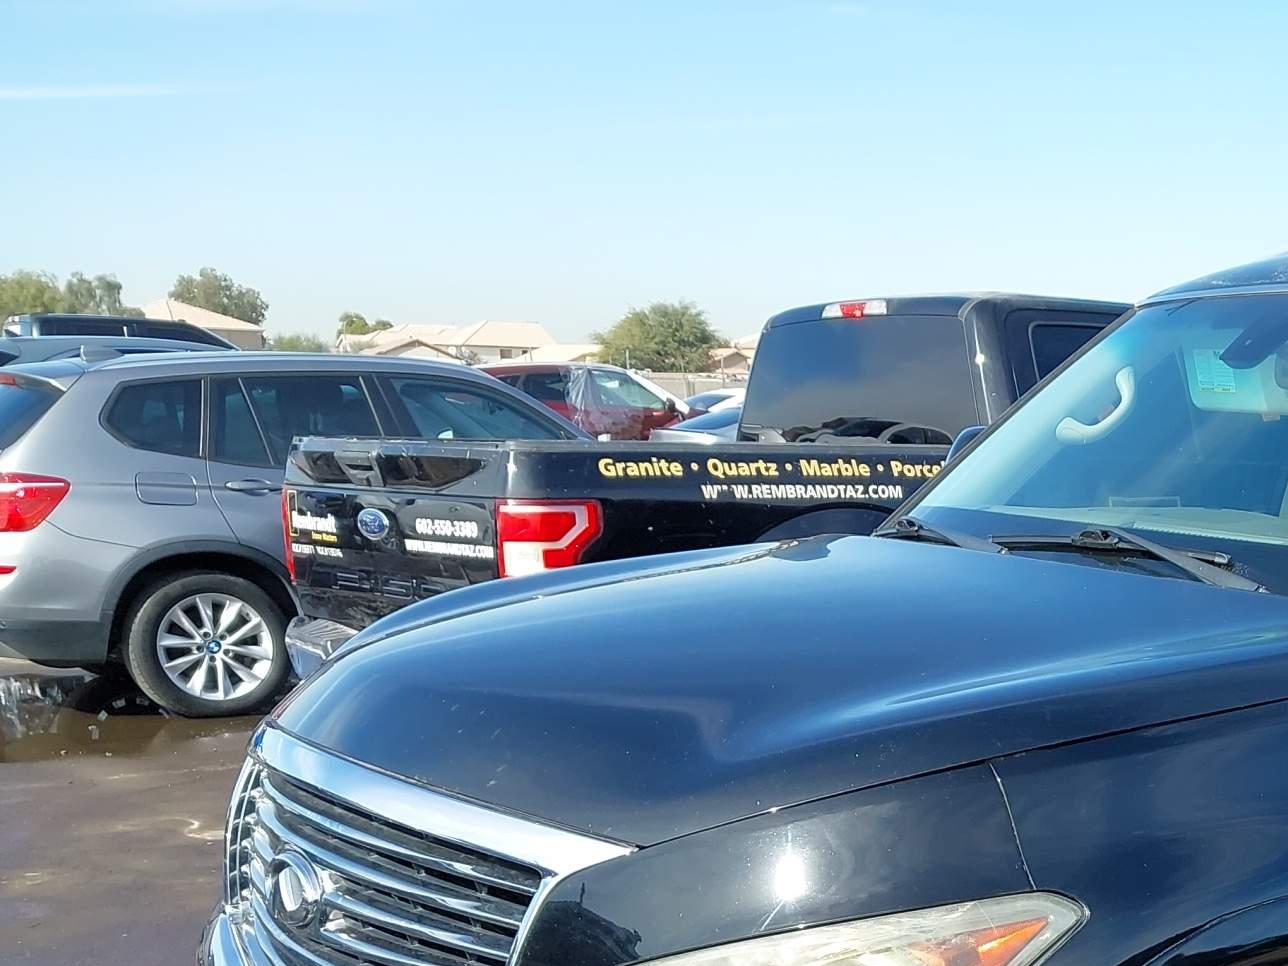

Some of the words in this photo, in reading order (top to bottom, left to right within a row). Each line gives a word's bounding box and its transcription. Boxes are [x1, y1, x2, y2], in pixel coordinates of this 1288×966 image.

[598, 456, 684, 478] Granite
[706, 457, 780, 479] Quartz
[799, 458, 871, 478] Marble
[701, 482, 903, 500] WW.REMBRANDTAZ.COM
